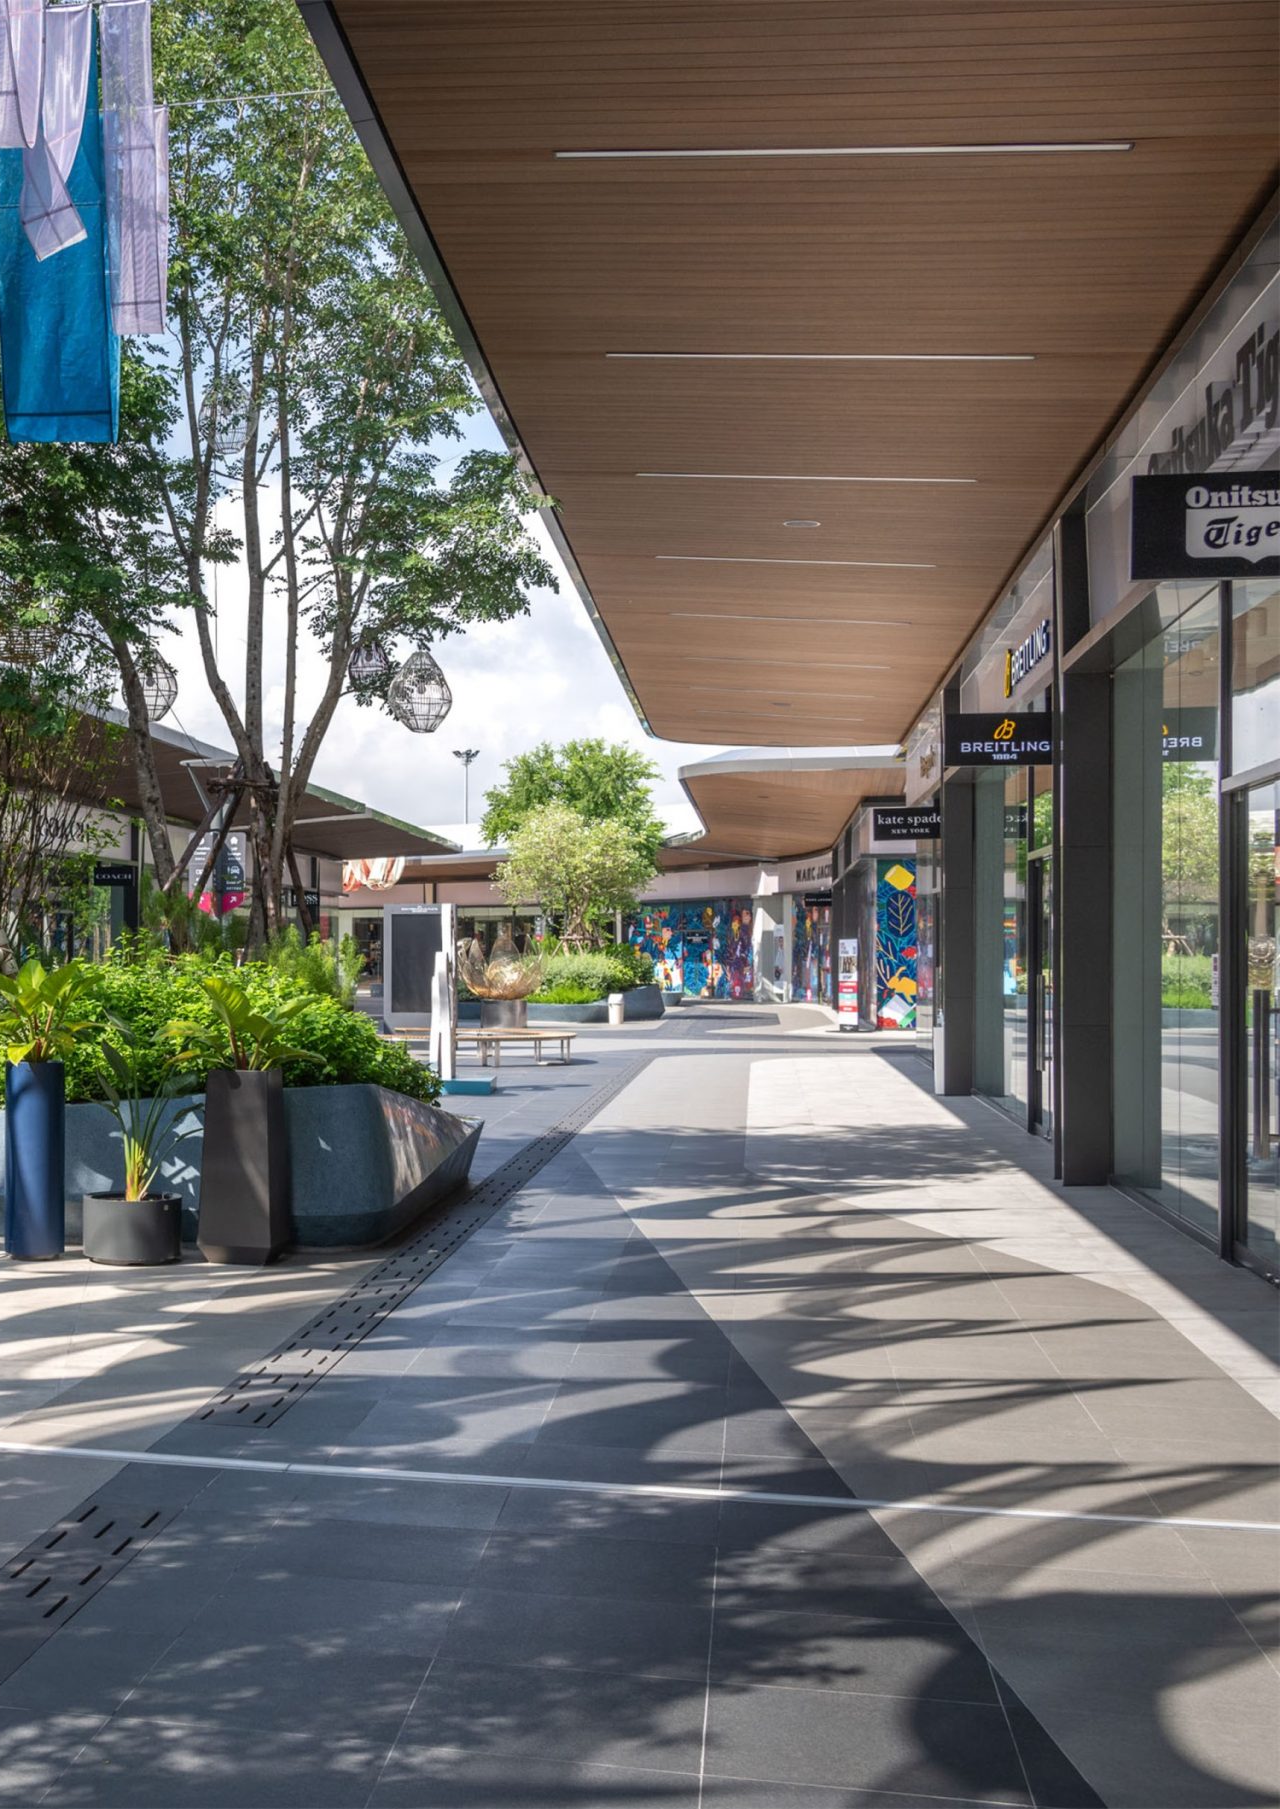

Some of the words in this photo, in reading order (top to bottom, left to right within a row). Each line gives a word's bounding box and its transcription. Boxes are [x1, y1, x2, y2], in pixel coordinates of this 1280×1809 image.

[1011, 619, 1051, 687] BREITLING
[961, 741, 1051, 752] BREITLING
[877, 814, 904, 825] kate
[796, 866, 815, 882] MARC
